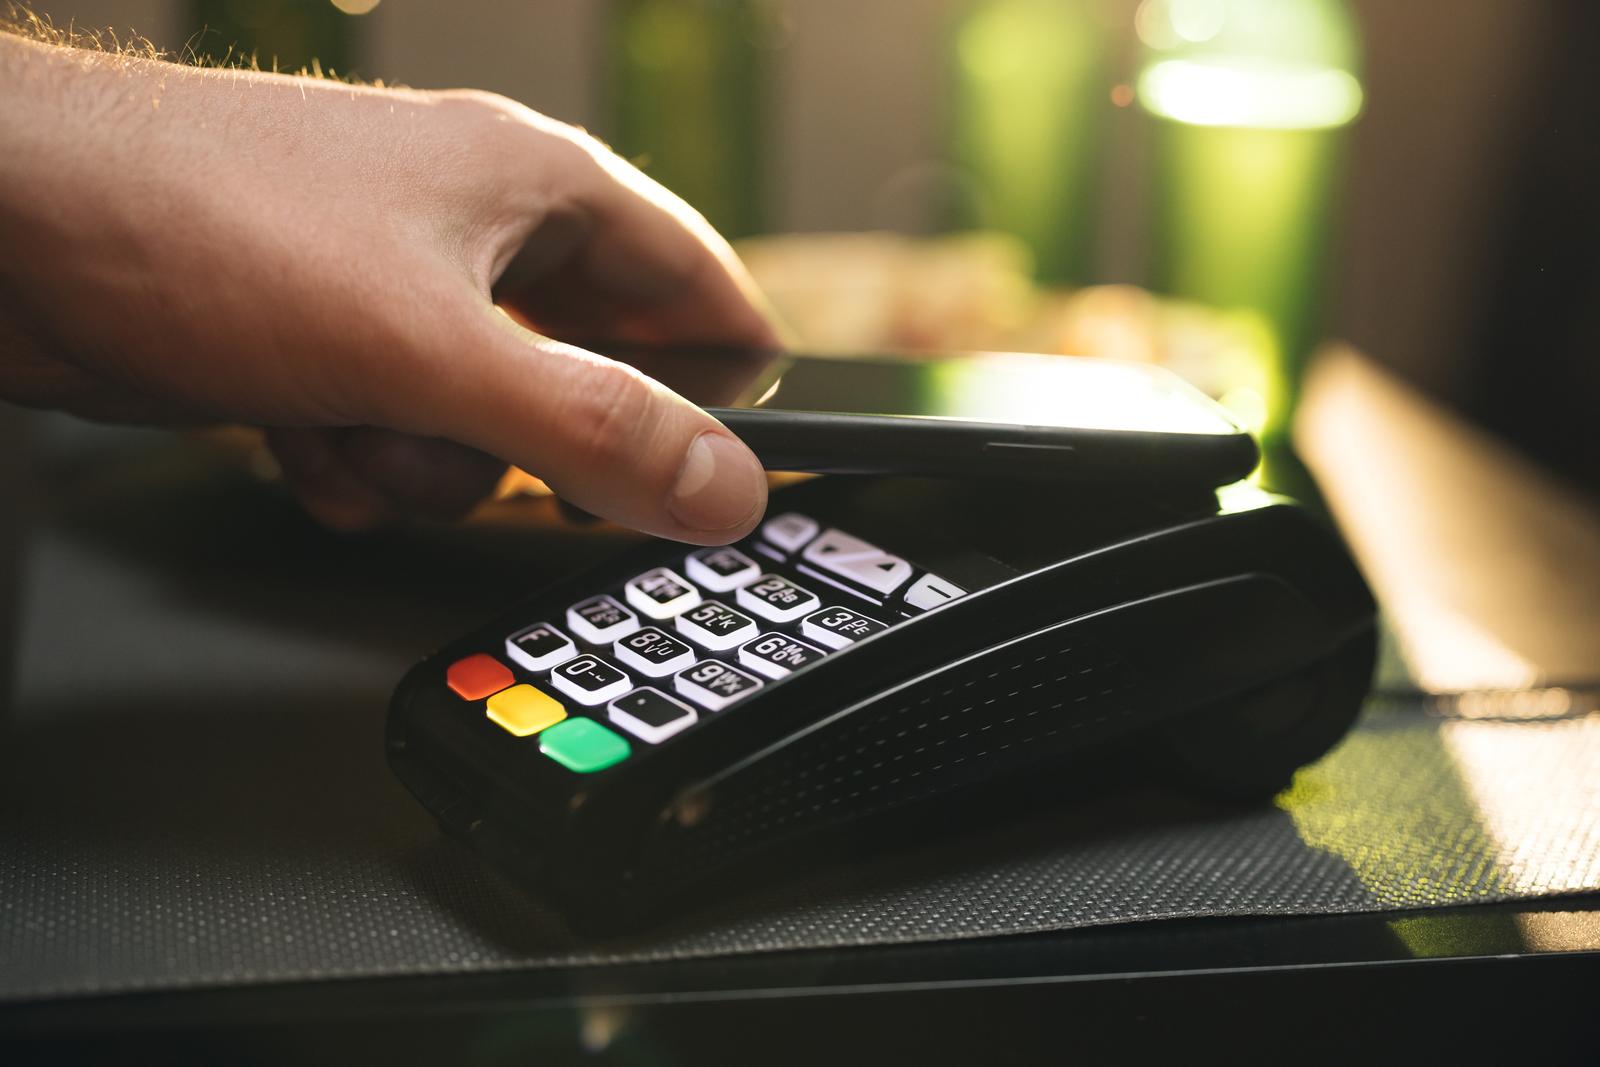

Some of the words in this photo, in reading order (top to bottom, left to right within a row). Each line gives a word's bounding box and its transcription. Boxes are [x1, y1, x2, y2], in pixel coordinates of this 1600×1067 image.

[753, 580, 784, 595] 2
[692, 605, 718, 620] 5
[821, 612, 853, 627] 3
[517, 628, 549, 643] F
[630, 633, 661, 648] 8
[755, 637, 787, 655] 6
[565, 660, 598, 676] 0
[691, 665, 724, 682] 9
